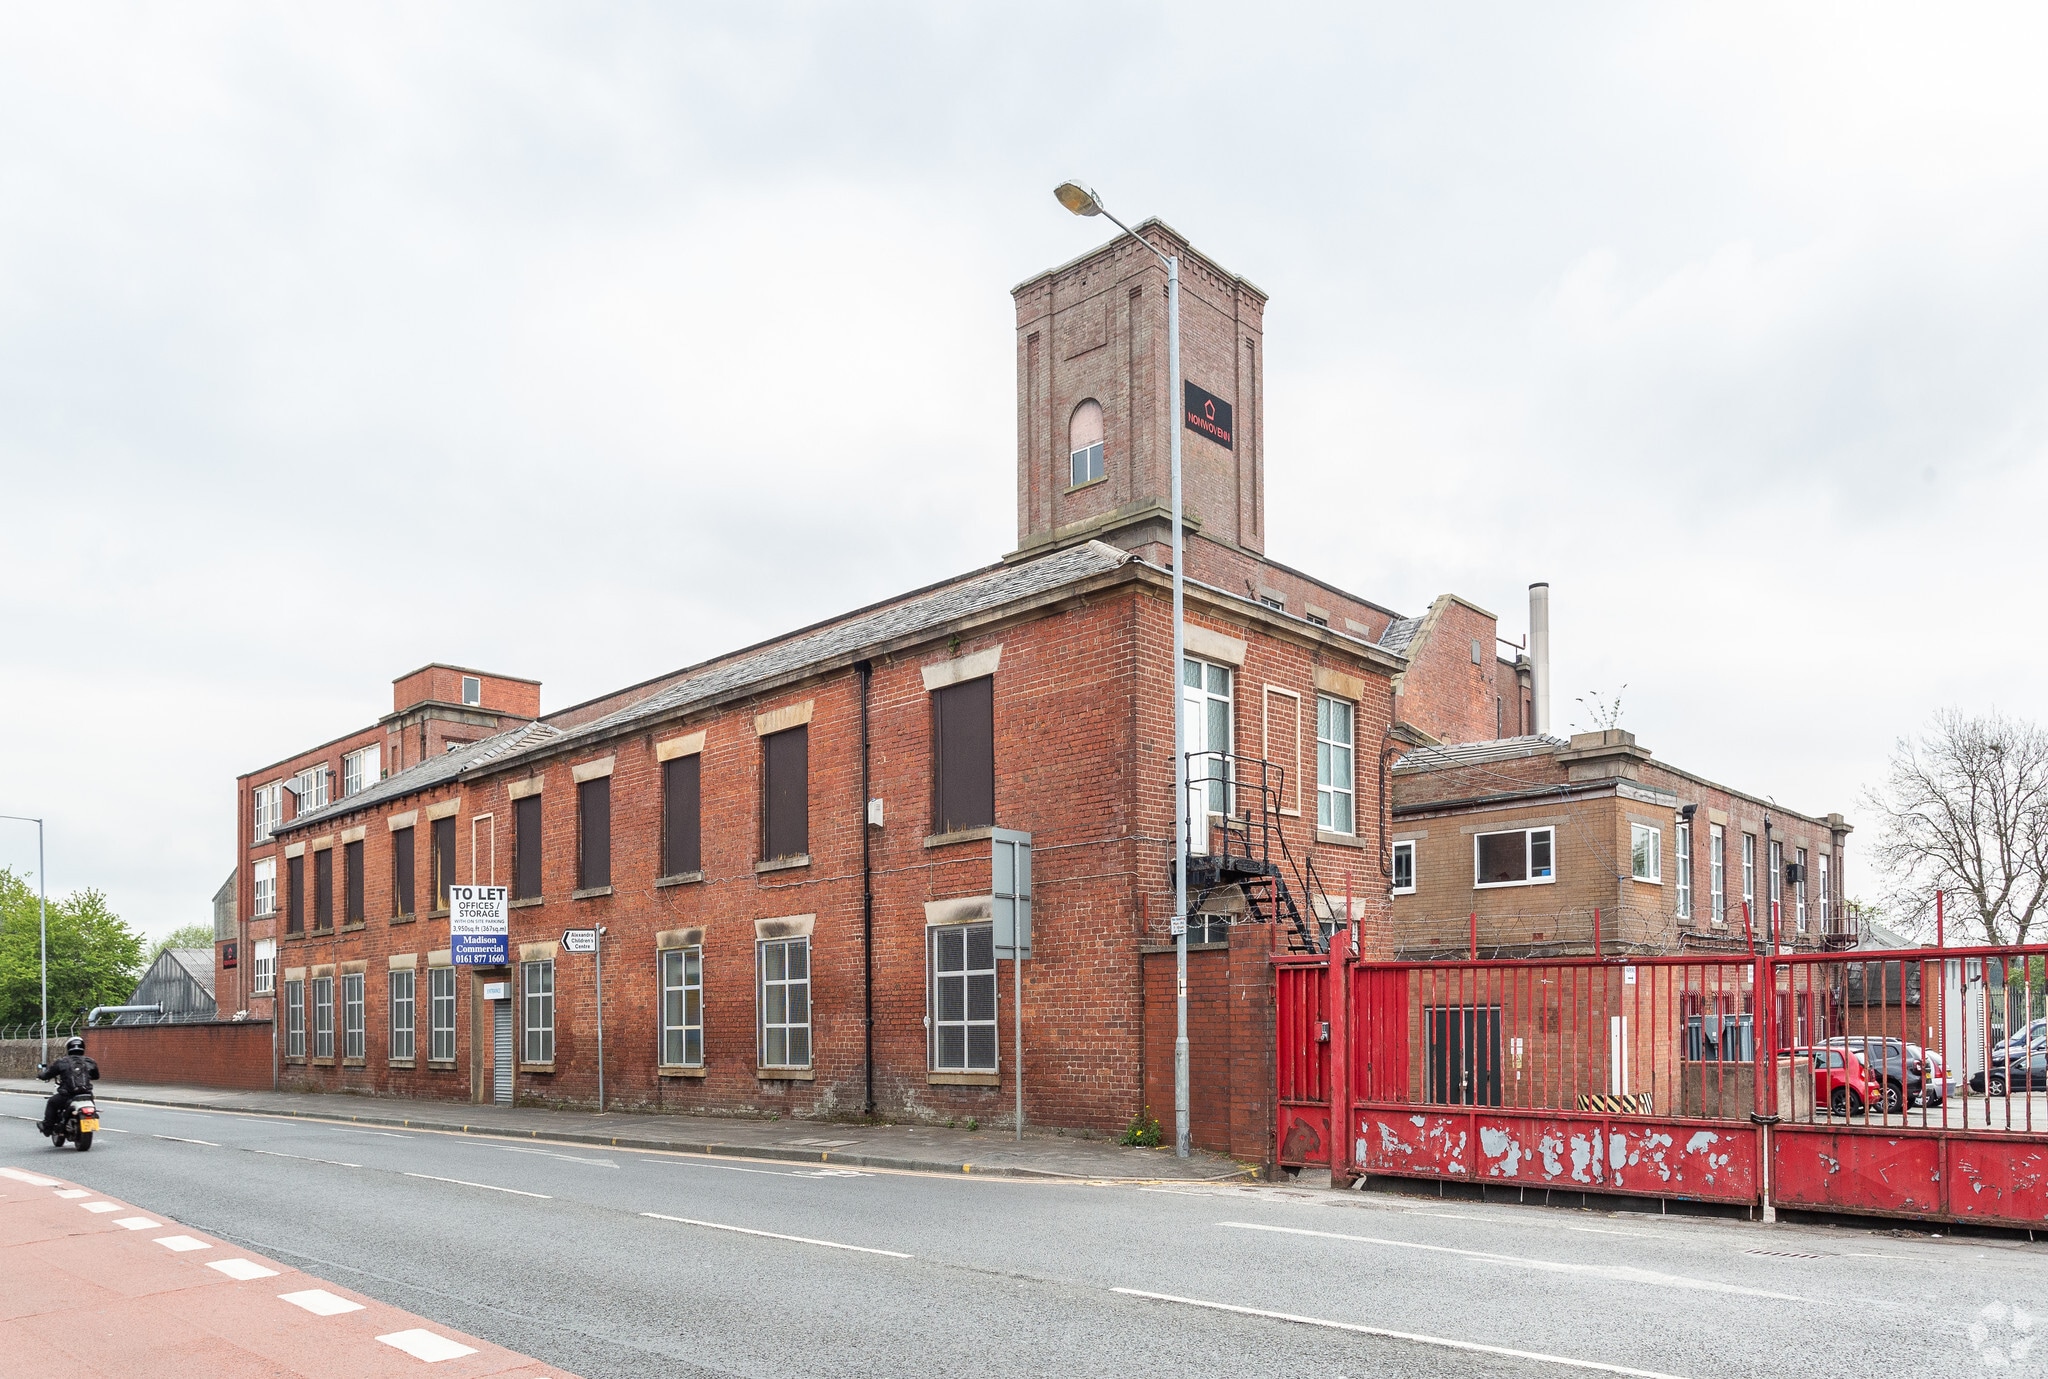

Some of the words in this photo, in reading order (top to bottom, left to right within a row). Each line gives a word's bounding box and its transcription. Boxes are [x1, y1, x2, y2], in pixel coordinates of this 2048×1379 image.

[452, 887, 473, 900] TO
[478, 887, 506, 901] LET
[458, 901, 495, 910] OFFICES
[459, 909, 500, 918] STORAGE
[463, 935, 497, 944] Madison
[456, 944, 504, 953] Commercial
[455, 954, 472, 963] 0161
[473, 954, 487, 963] 877
[488, 954, 505, 963] 1660
